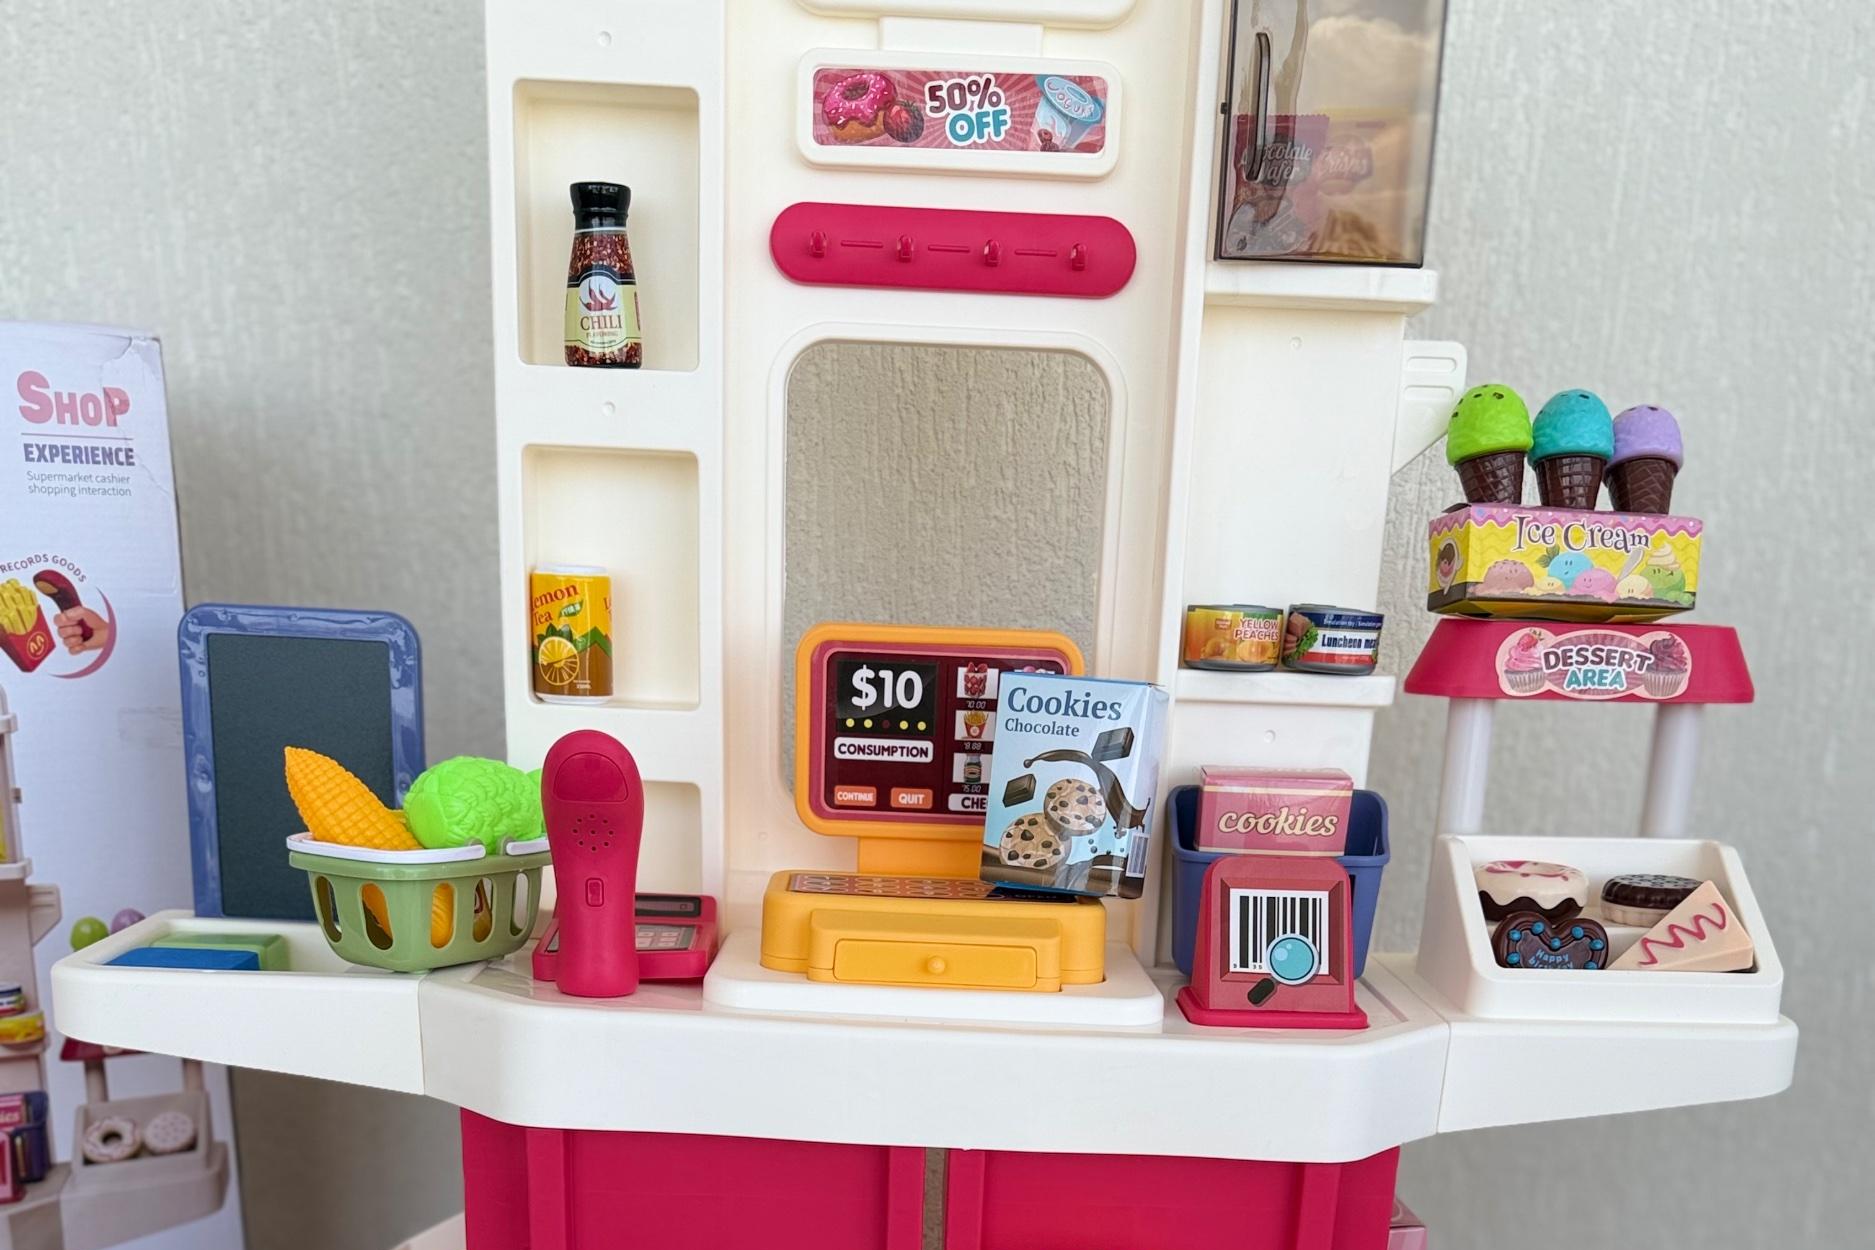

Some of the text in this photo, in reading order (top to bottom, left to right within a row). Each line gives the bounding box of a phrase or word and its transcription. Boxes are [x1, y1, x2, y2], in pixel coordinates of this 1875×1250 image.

[927, 78, 1003, 114] 50%
[949, 109, 1008, 142] OFF
[580, 314, 622, 331] CHILI
[16, 370, 131, 427] SHOP
[23, 443, 136, 467] EXPERIENCE
[26, 470, 131, 485] Supermarket cashier
[28, 483, 132, 498] shopping interaction
[1514, 515, 1650, 553] Ice Cream
[0, 554, 87, 582] RECORDS GOODS
[1240, 618, 1278, 630] YELLOW
[1235, 629, 1279, 641] PEACHES
[1321, 633, 1362, 648] Luncheon
[1543, 647, 1653, 671] DESSERT
[851, 664, 924, 711] $10
[1565, 669, 1626, 689] AREA
[1006, 687, 1122, 721] Cookies
[1005, 718, 1080, 738] Chocolate
[837, 743, 929, 759] CONSUMPTION
[836, 791, 874, 803] CONTINUE
[898, 792, 925, 806] QUIT
[1218, 807, 1339, 837] cookies
[1536, 949, 1569, 963] Happy
